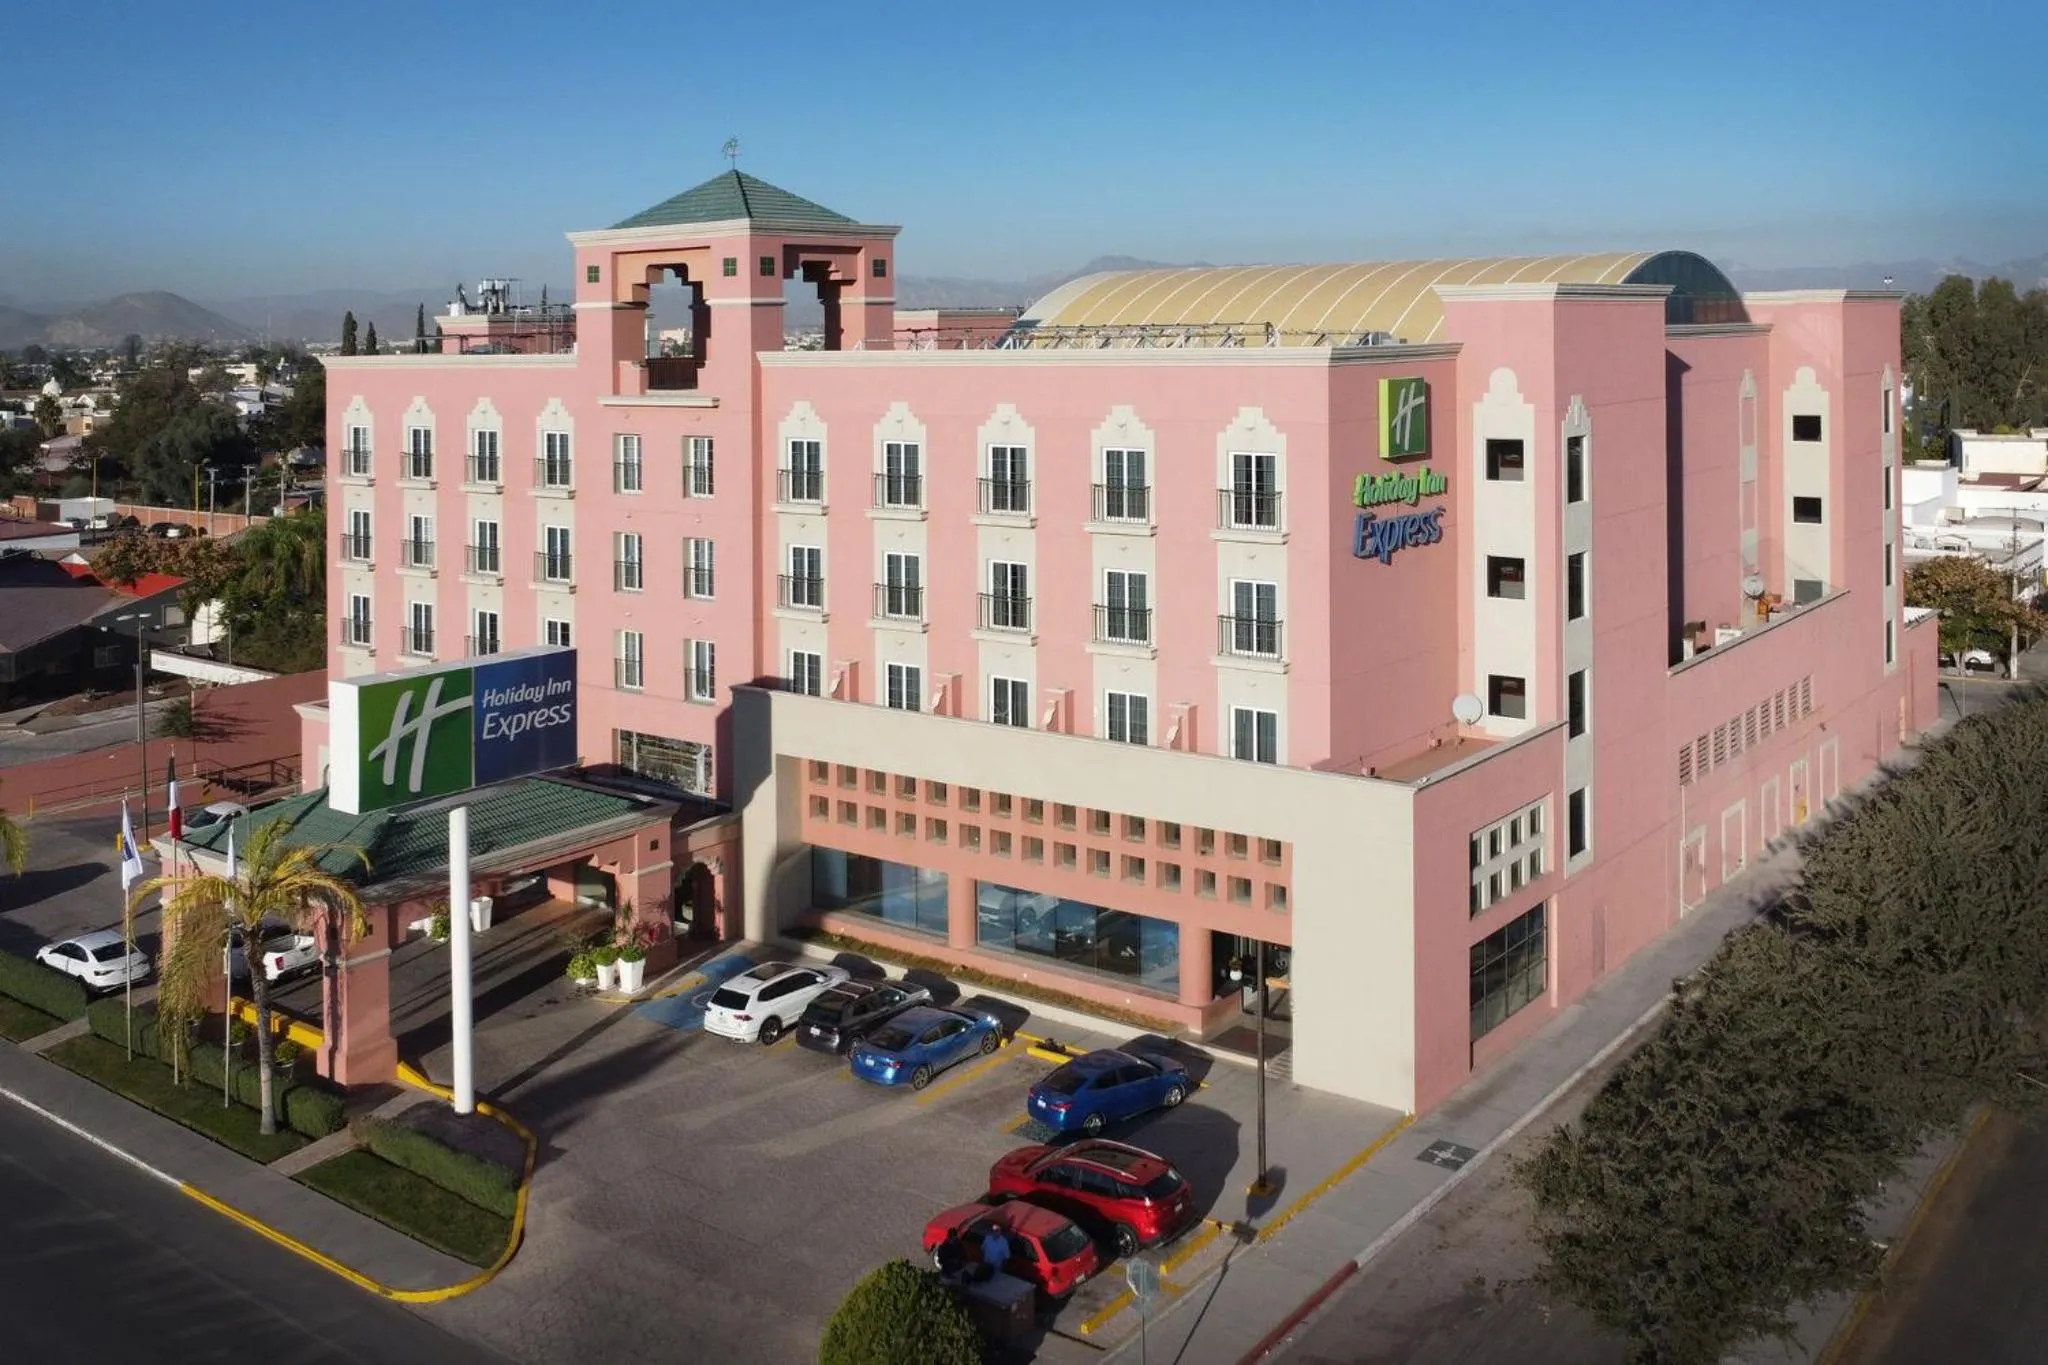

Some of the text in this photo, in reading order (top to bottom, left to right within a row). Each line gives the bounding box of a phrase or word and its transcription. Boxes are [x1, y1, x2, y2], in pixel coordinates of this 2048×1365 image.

[1355, 464, 1446, 506] Holiday Inn
[1353, 507, 1445, 564] Express
[482, 677, 571, 709] Holiday Inn
[482, 703, 571, 741] Express
